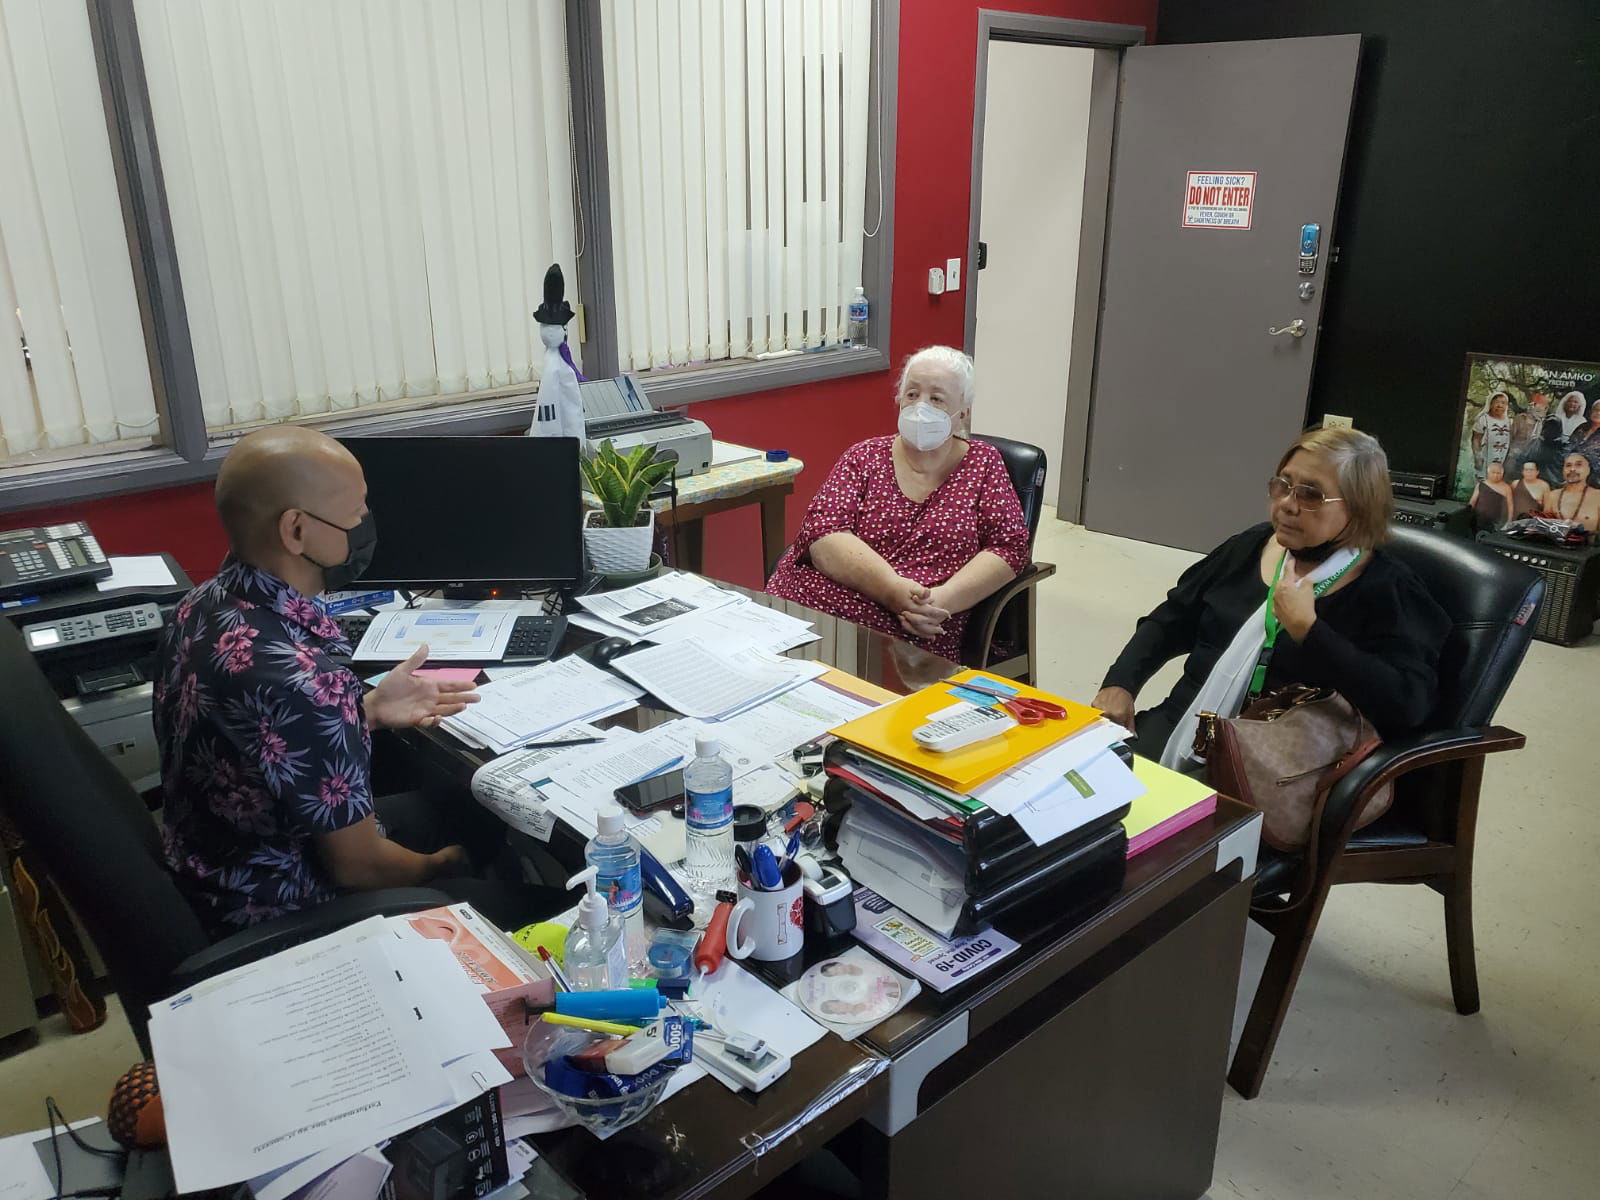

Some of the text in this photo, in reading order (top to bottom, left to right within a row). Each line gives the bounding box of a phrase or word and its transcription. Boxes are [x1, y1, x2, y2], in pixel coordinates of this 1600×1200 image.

[1197, 175, 1246, 186] FEELING SICK?
[1189, 186, 1250, 207] DO NOT ENTER
[935, 939, 993, 972] COVID-19
